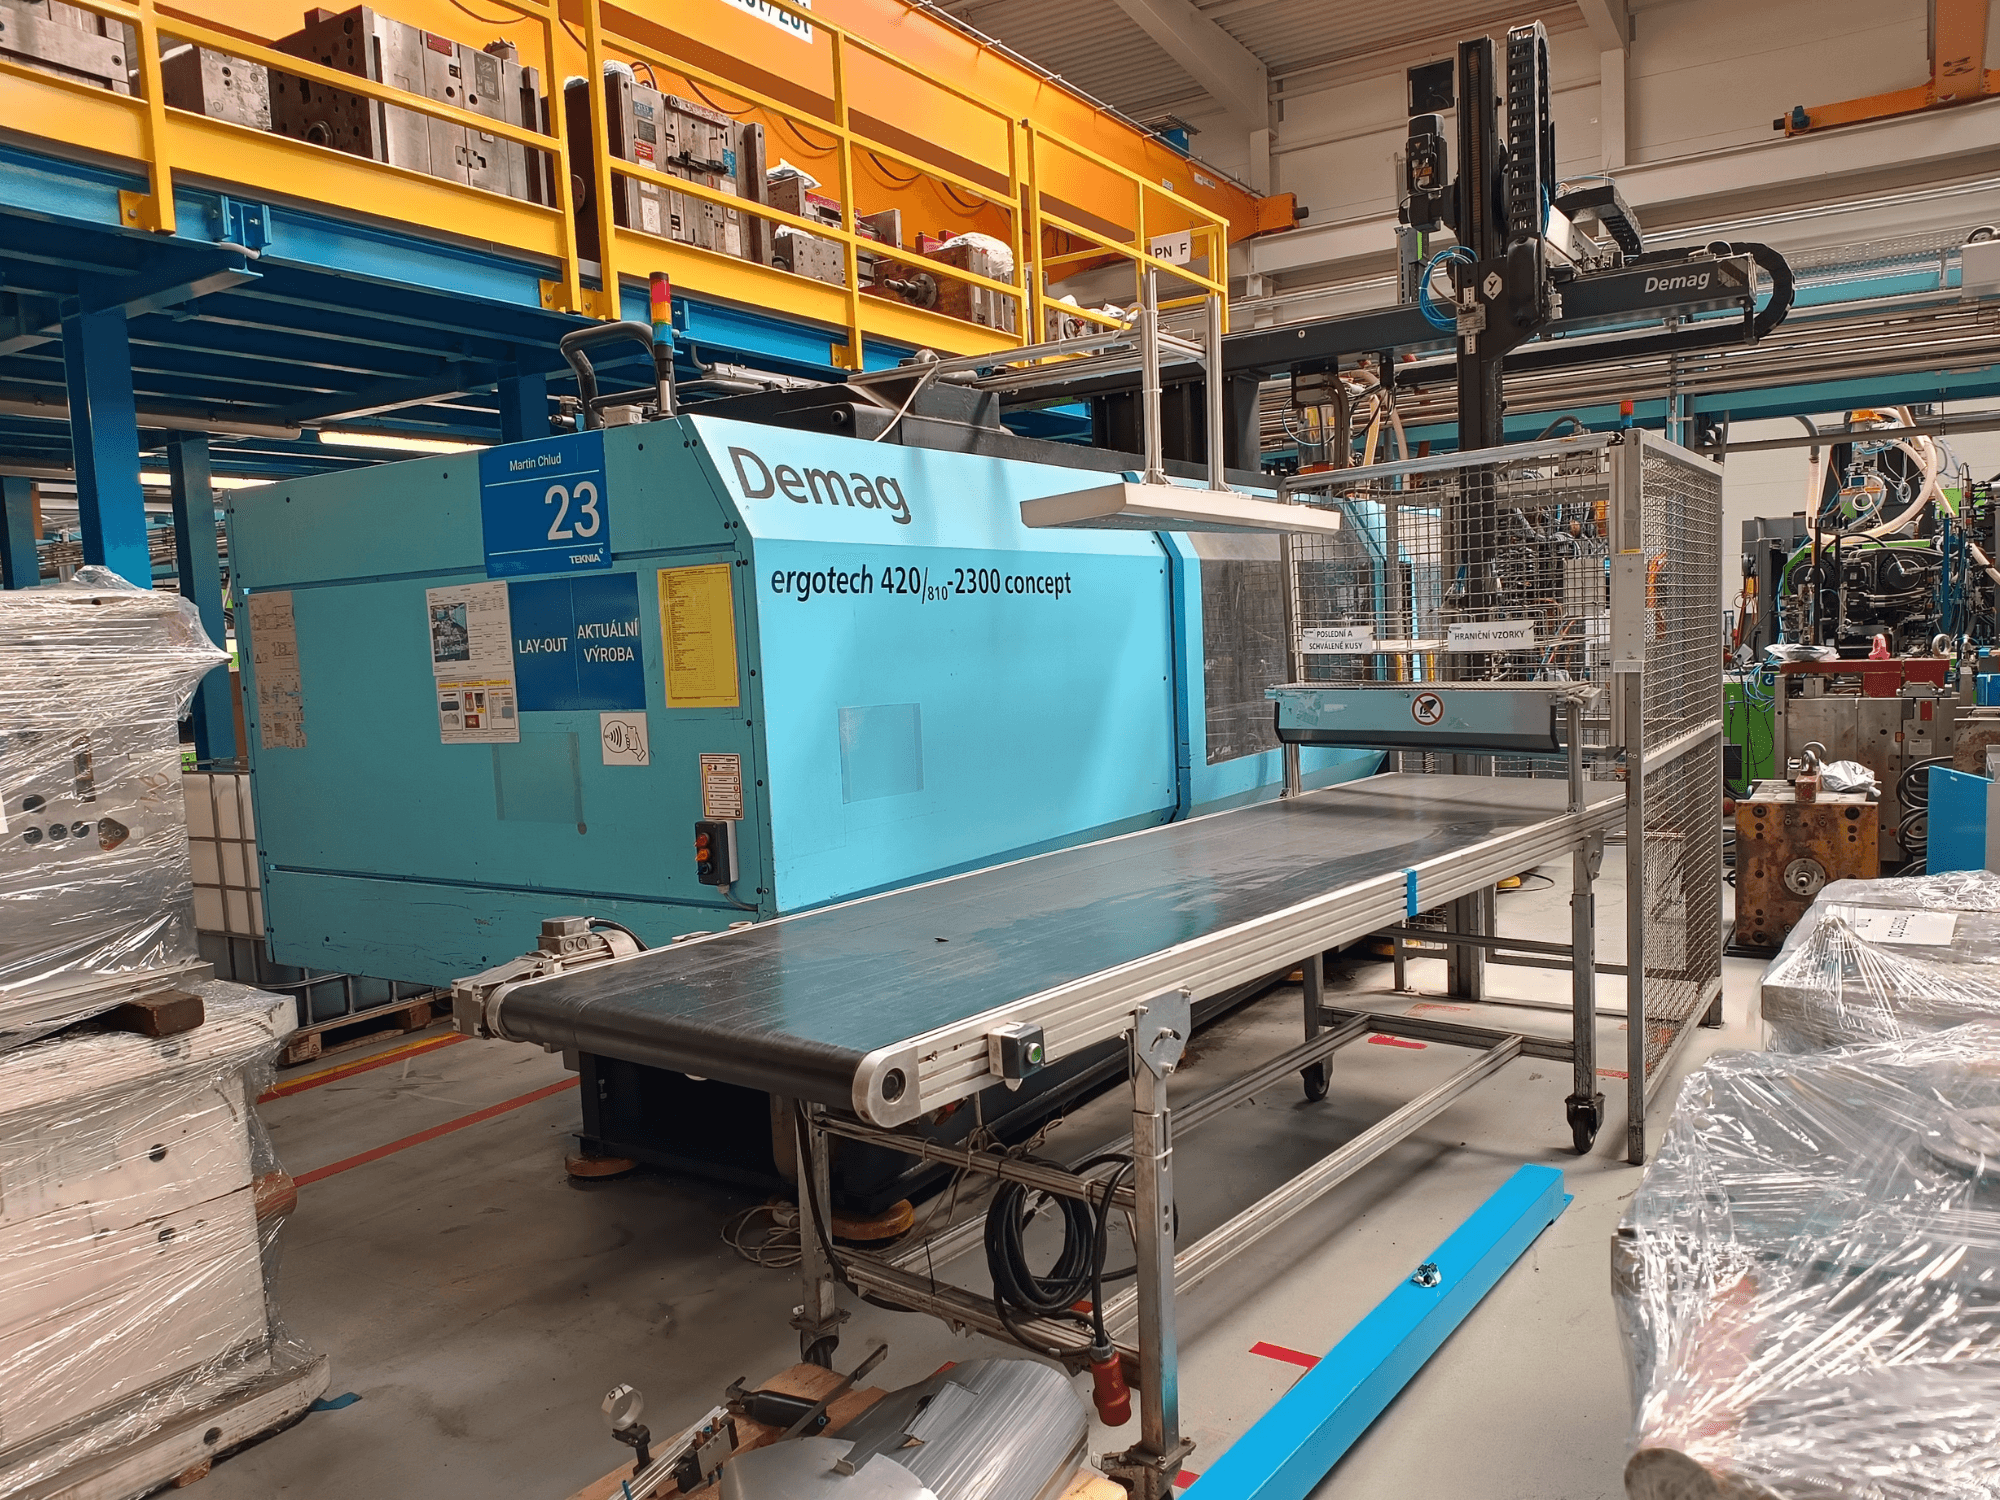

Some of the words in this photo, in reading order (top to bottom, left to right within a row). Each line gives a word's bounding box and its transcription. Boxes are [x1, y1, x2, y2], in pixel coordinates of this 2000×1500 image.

[1154, 245, 1172, 259] PN
[1180, 243, 1188, 255] F
[1644, 271, 1711, 294] Demag
[509, 457, 536, 472] Martin
[538, 452, 562, 467] Chlud
[727, 445, 912, 525] Demag
[544, 480, 600, 541] 23
[568, 553, 601, 564] TEKNIA
[770, 563, 874, 602] ergotech
[1004, 571, 1072, 600] concept
[577, 617, 640, 639] AKTUÁLNÍ
[1316, 629, 1346, 638] POSLEDNÍ
[1454, 629, 1491, 640] HRANIČNÍ
[1492, 630, 1525, 639] VZORKY
[518, 637, 568, 654] LAY-OUT
[584, 645, 635, 663] VÝROBA
[1309, 640, 1344, 650] SCHVÁLENÉ
[1345, 642, 1363, 650] KUSY
